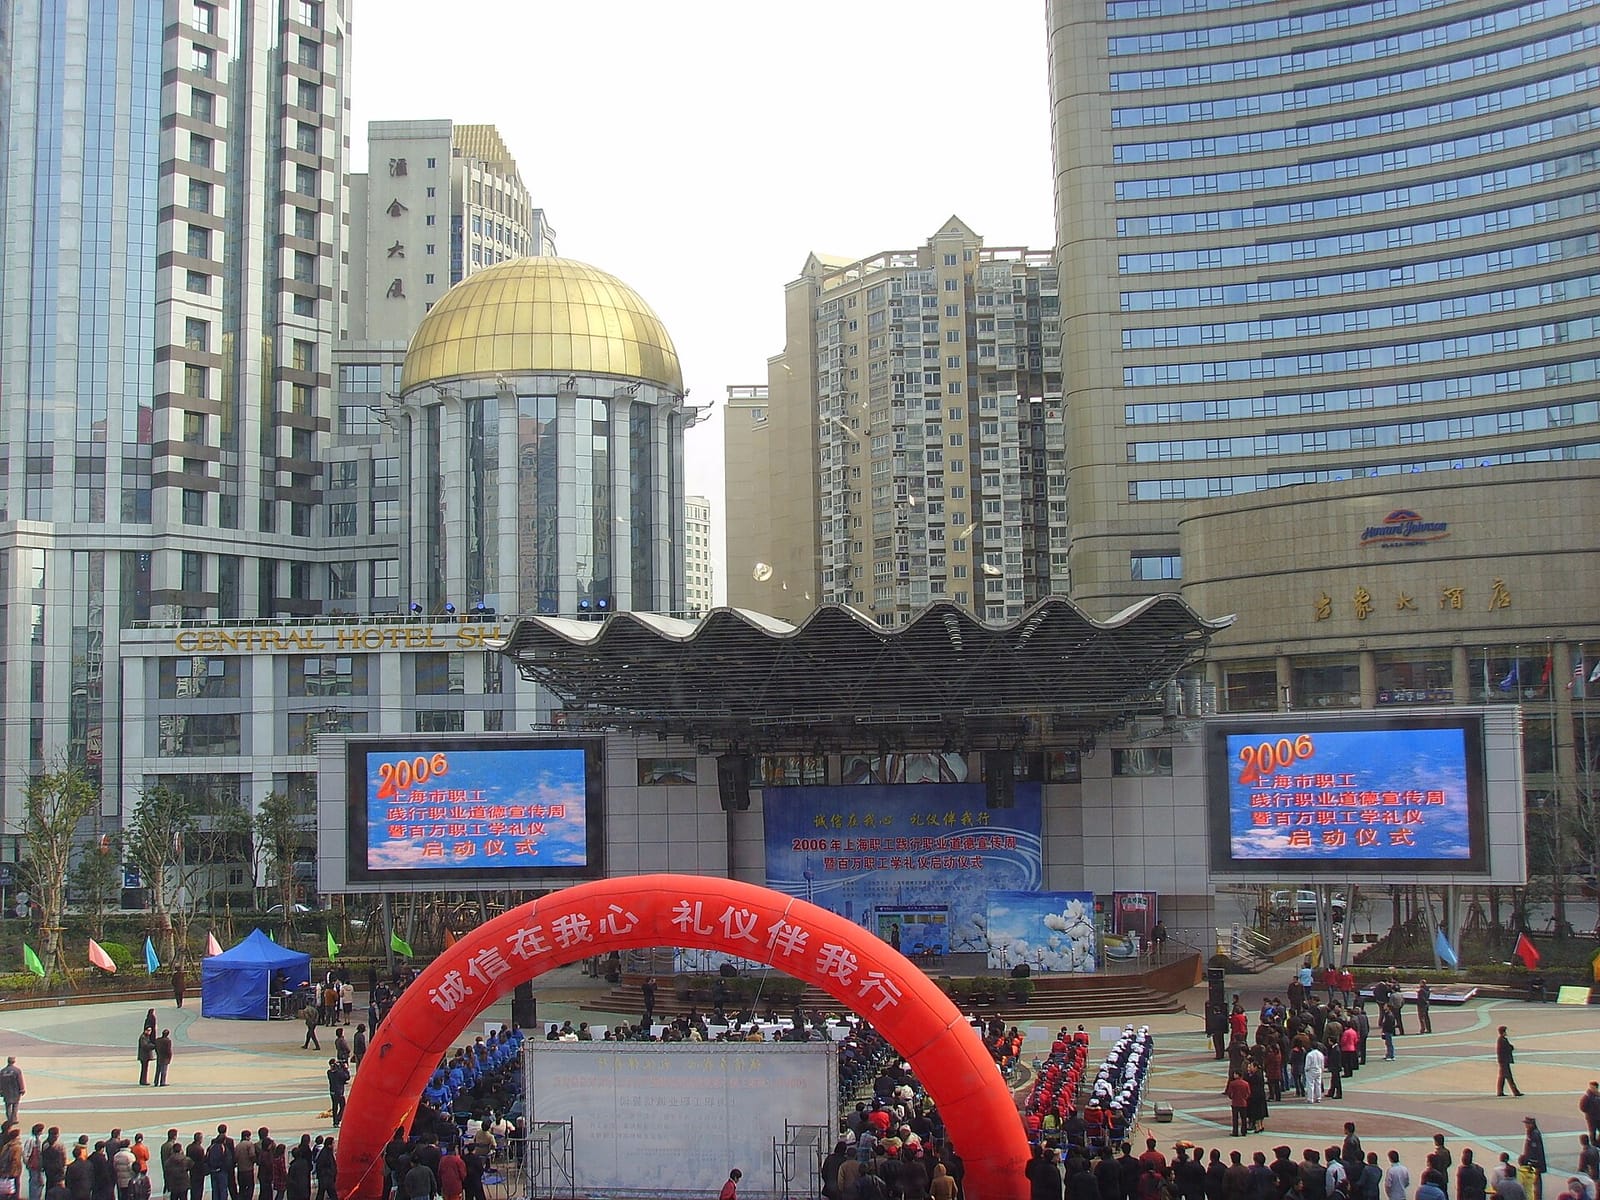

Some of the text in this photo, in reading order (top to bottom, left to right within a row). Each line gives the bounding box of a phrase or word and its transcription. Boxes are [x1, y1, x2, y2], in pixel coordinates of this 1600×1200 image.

[1402, 521, 1447, 537] Johnson
[175, 628, 325, 651] CENTRAL
[337, 627, 444, 649] HOTEL
[1239, 734, 1314, 784] 2006
[377, 753, 448, 799] 2006
[1252, 774, 1357, 789] 上海市职工
[387, 789, 487, 804] 上海市职工
[1251, 790, 1446, 808] 践行职业道德宣传周
[387, 804, 566, 821] 践行职业道德宣传周
[814, 811, 991, 830] 诚信在我心 礼仪伴我行
[1252, 810, 1425, 827] 暨百万职工学礼仪
[388, 822, 547, 838] 暨百万职工学礼仪
[824, 856, 984, 871] 暨百万职工学礼仪启动仪式
[429, 900, 903, 1013] 诚信在我心 礼仪伴我行
